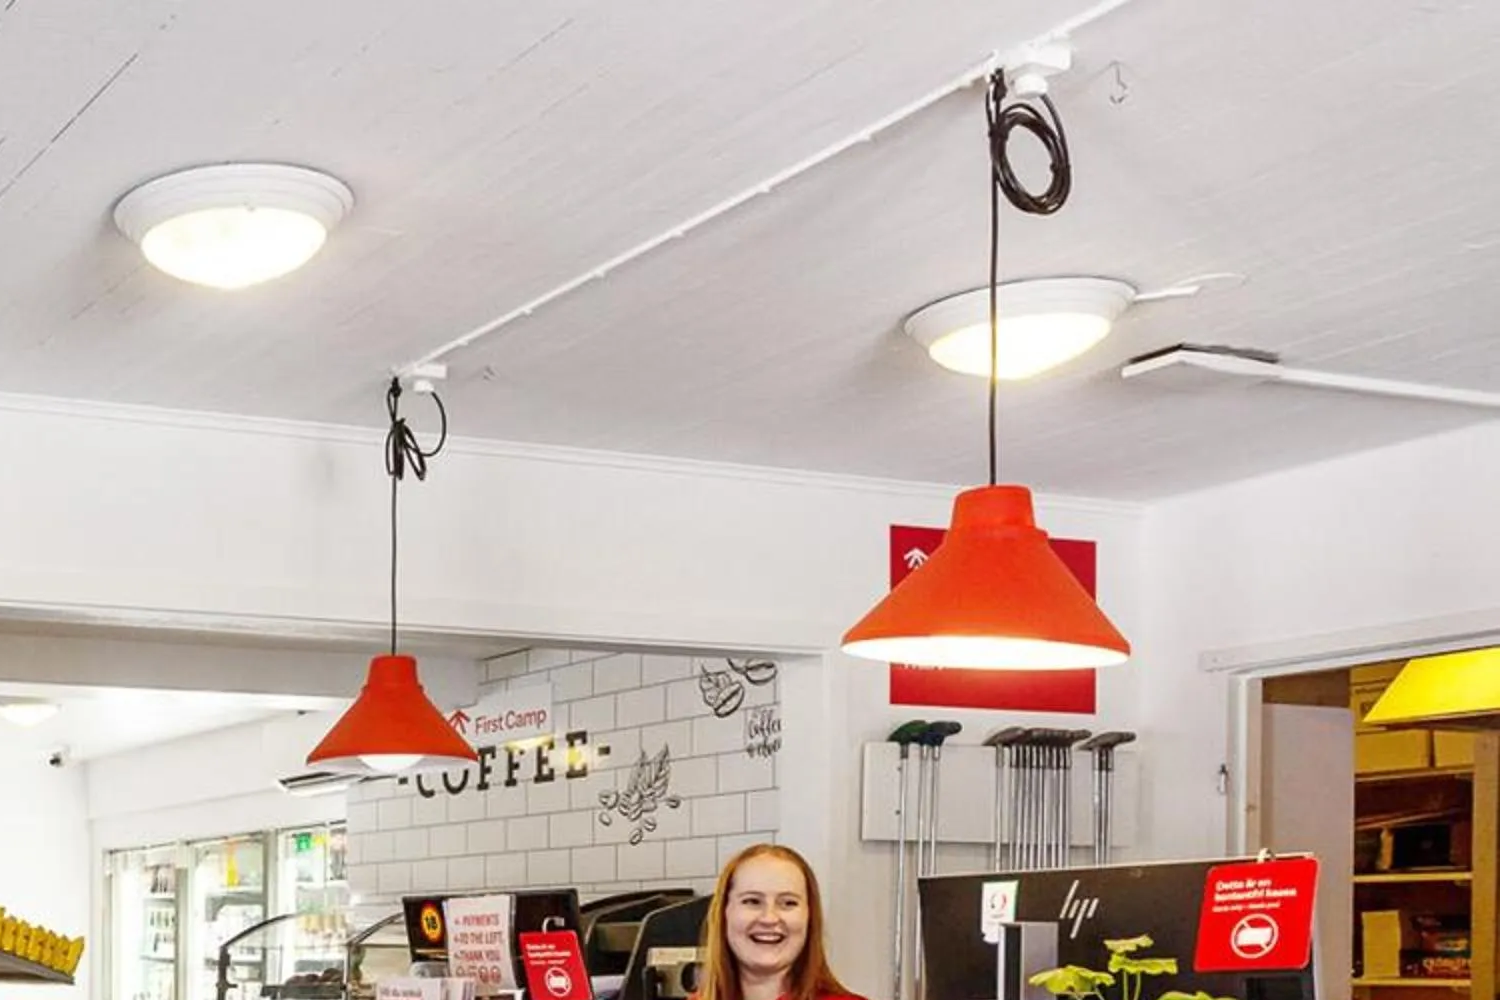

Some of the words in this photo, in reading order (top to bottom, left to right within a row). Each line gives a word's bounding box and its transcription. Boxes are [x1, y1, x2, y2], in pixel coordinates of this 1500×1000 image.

[475, 715, 504, 735] First
[505, 709, 547, 730] Camp
[1060, 879, 1099, 939] hp
